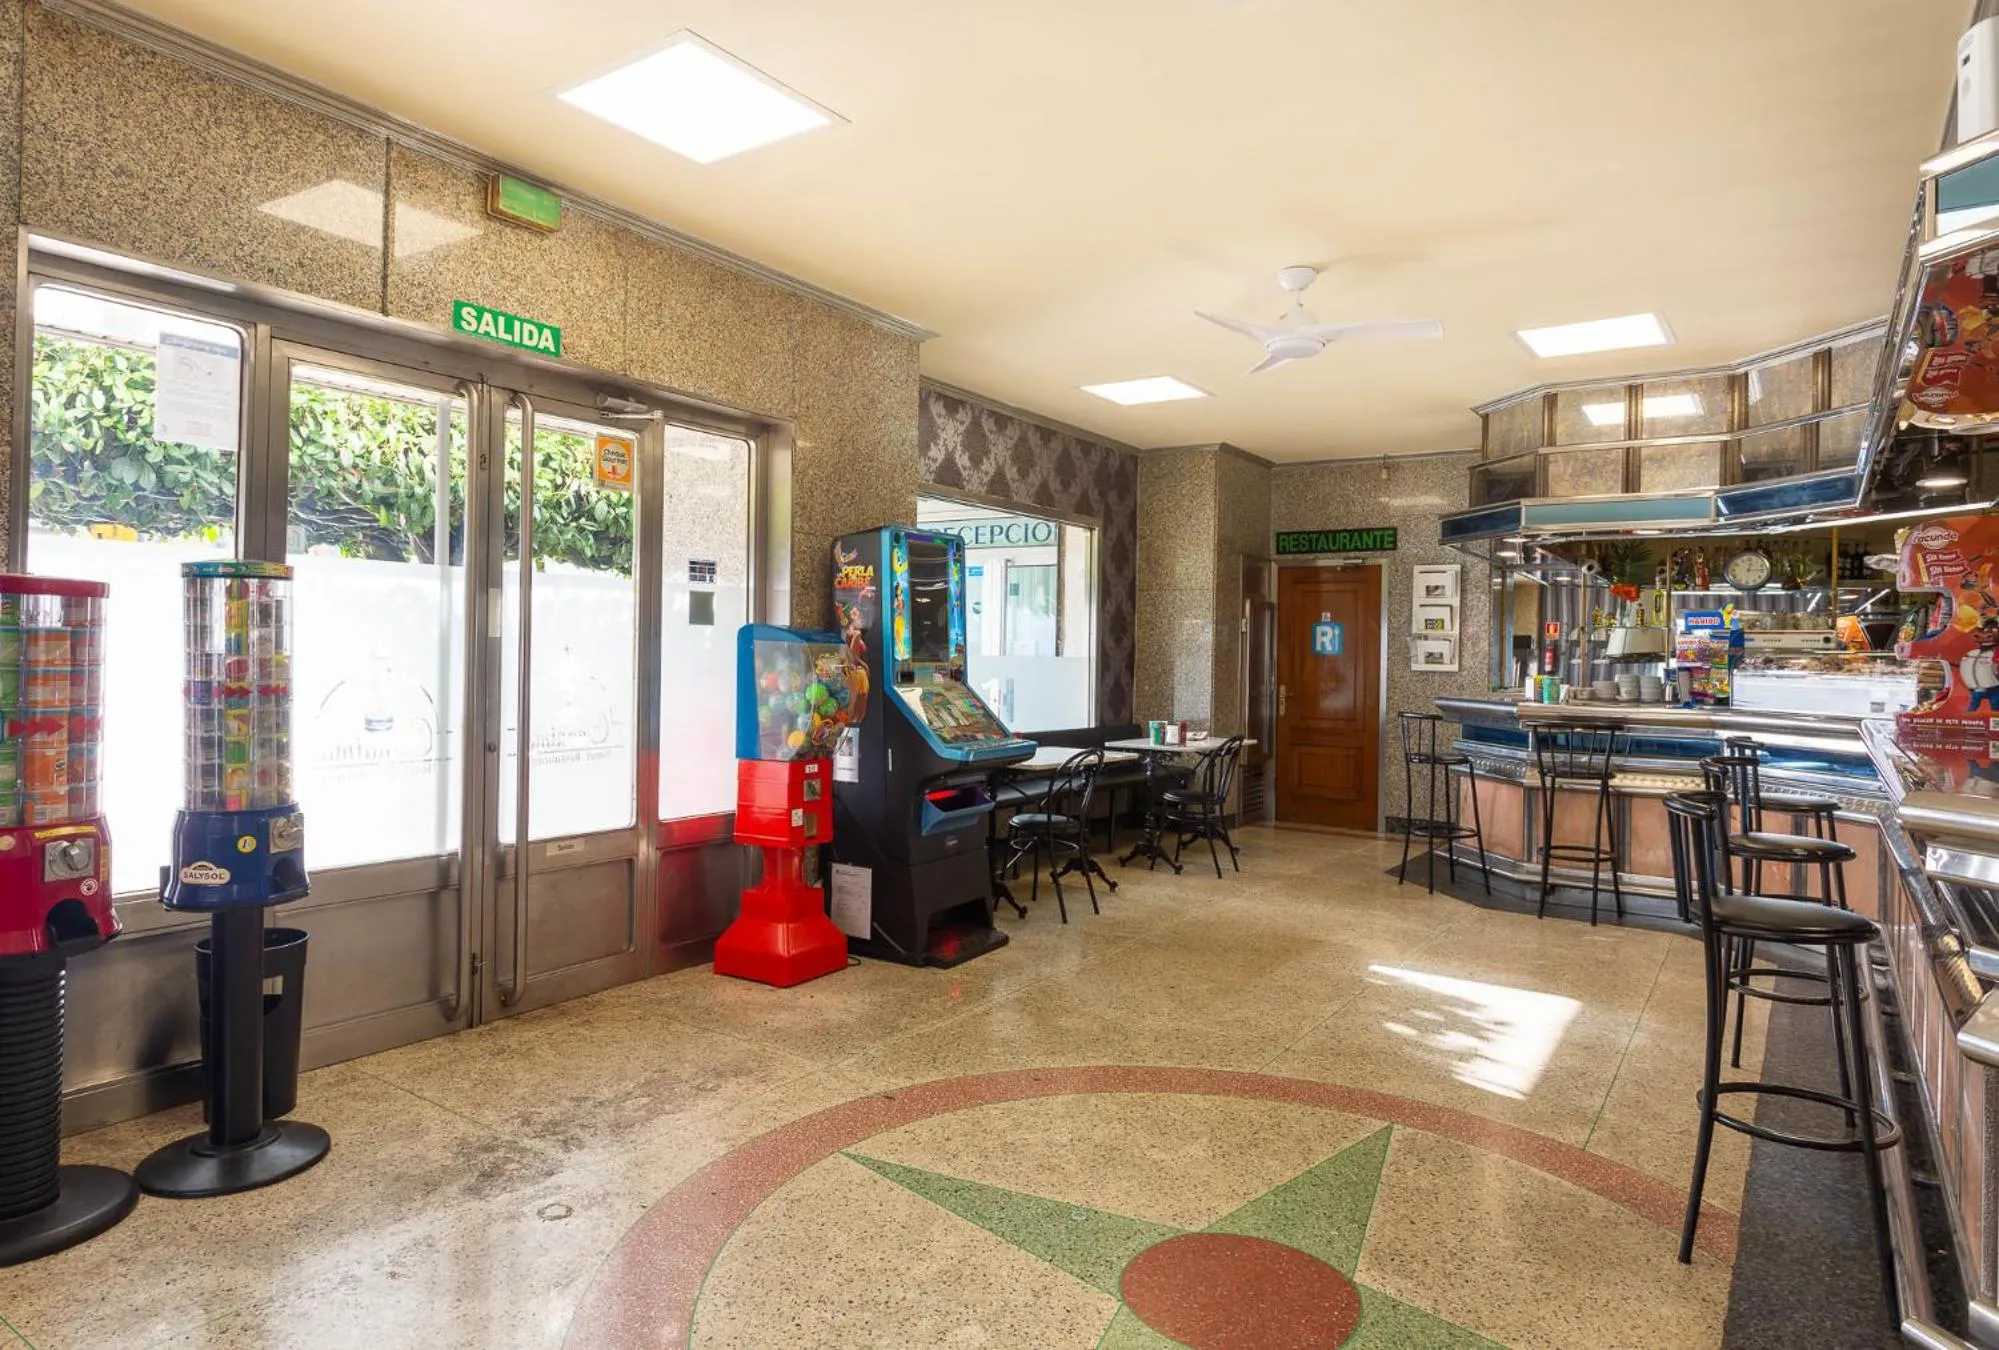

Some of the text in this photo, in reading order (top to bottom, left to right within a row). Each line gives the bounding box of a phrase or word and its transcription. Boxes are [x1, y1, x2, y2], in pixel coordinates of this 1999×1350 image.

[461, 306, 556, 353] SALIDA
[1279, 530, 1394, 552] RESTAURANTE
[841, 565, 875, 577] PERLA
[183, 871, 226, 880] SALYSOL
